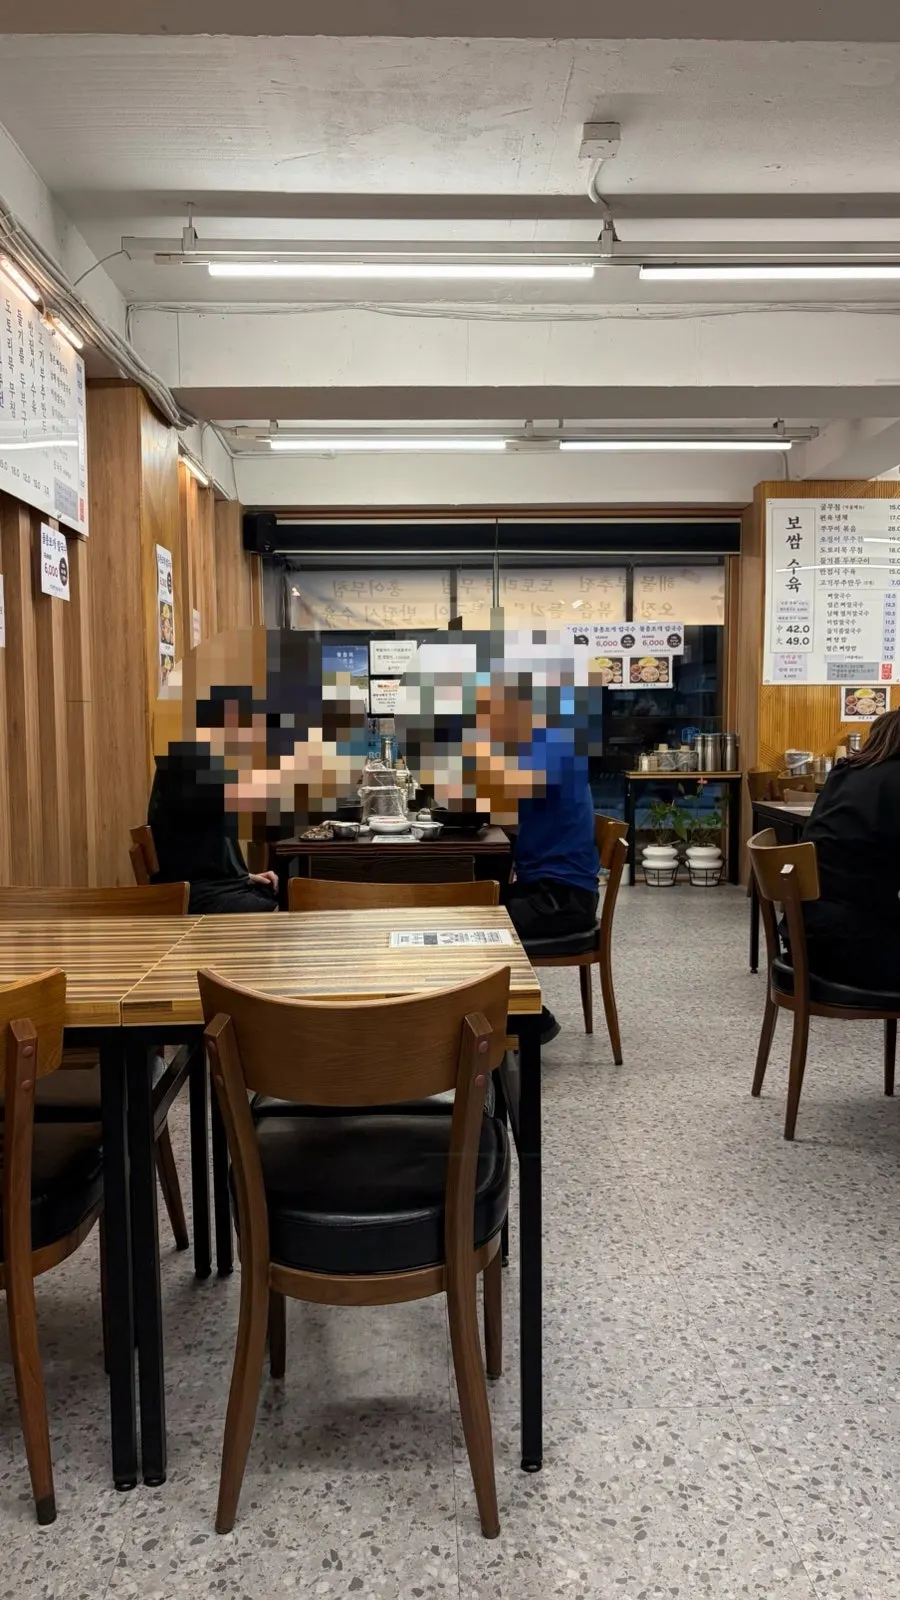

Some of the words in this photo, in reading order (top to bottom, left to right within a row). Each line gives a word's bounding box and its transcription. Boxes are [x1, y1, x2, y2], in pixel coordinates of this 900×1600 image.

[785, 516, 803, 550] 보쌈
[785, 558, 803, 593] 수육
[786, 625, 810, 634] 42.0
[785, 637, 810, 645] 49.0
